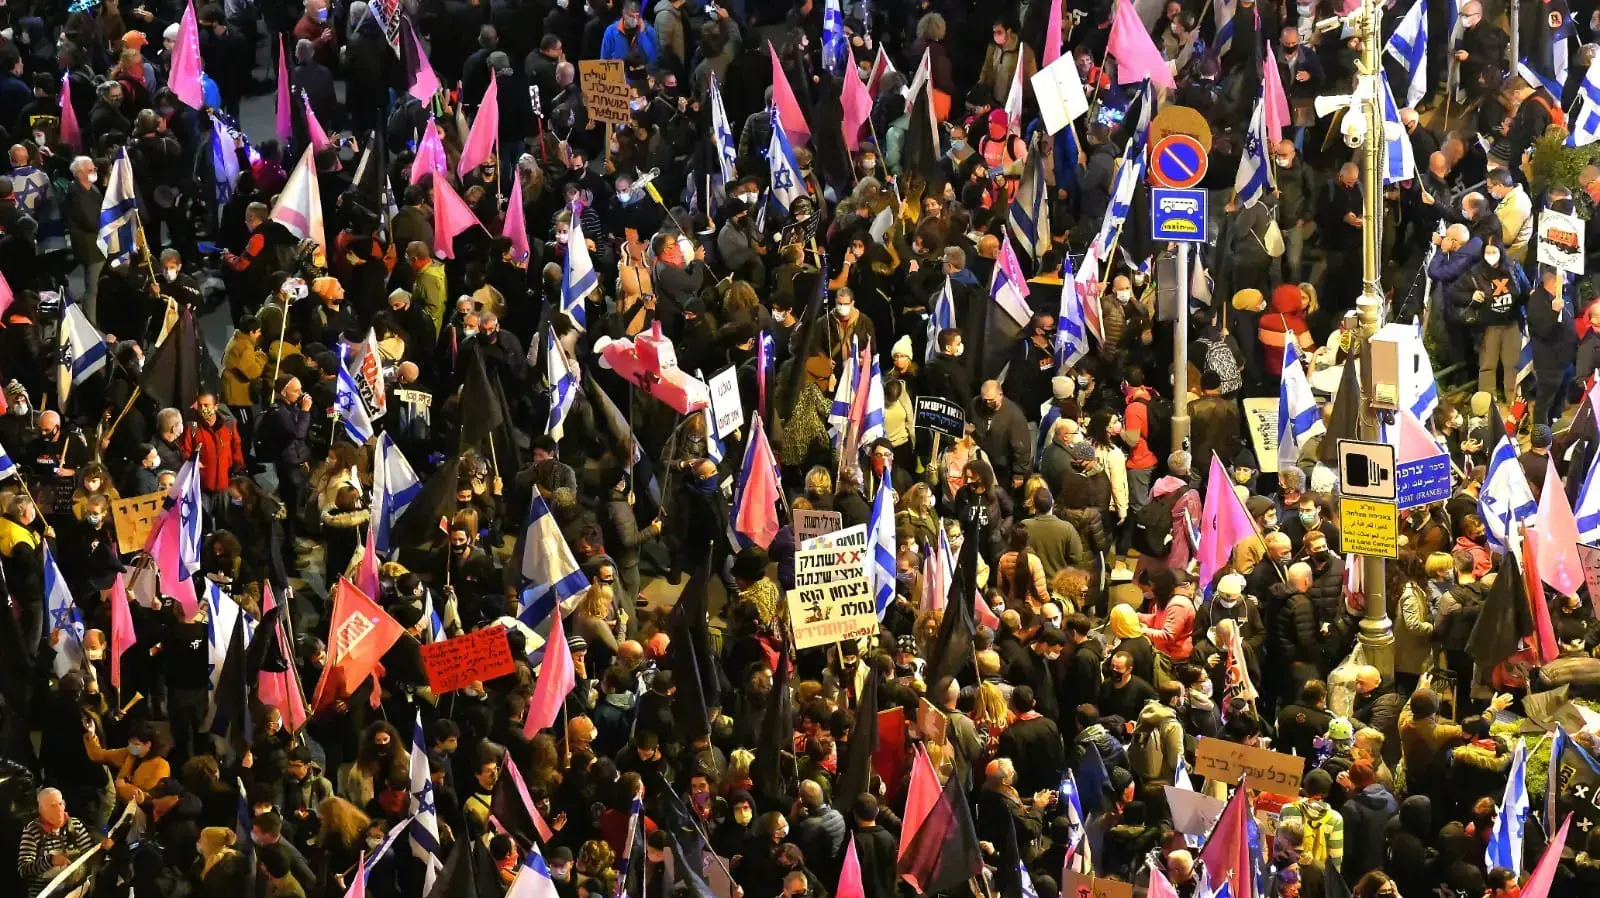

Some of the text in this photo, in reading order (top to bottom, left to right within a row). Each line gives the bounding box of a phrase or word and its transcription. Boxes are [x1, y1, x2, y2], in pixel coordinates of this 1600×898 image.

[590, 95, 628, 110] מושחת
[590, 106, 629, 121] תתפטר
[1428, 462, 1445, 470] כיכר
[1352, 545, 1388, 554] Enforcement
[1373, 541, 1395, 549] Camera
[797, 567, 863, 586] ארצי שינתה
[800, 582, 869, 603] ניצחון הוא
[841, 600, 875, 616] נחלת
[1267, 765, 1300, 787] הכל
